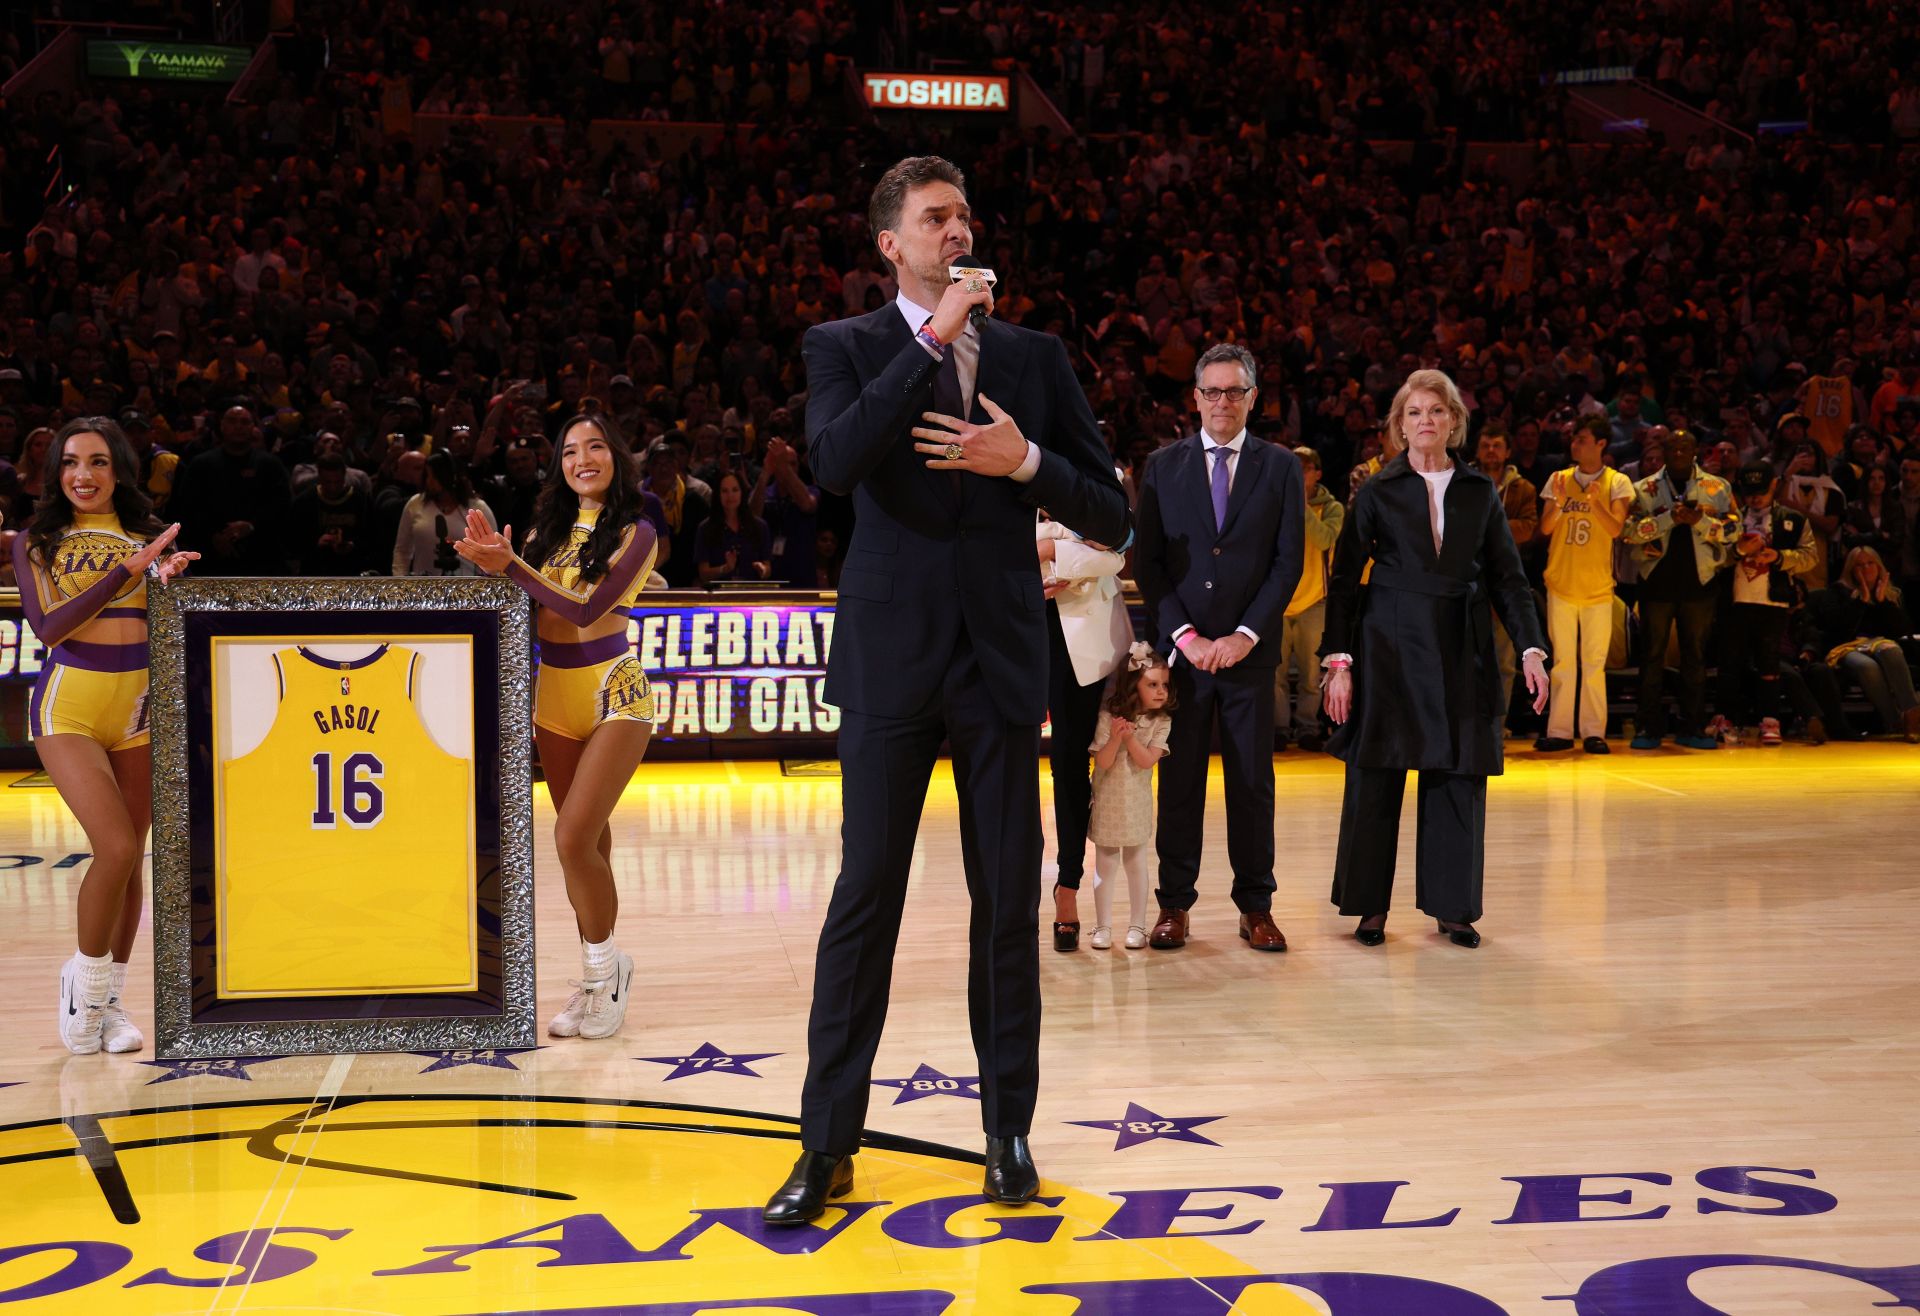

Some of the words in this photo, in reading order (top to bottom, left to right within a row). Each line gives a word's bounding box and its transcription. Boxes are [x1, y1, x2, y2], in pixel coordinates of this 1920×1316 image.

[866, 78, 1007, 108] TOSHIBA
[1815, 393, 1842, 418] 16
[1564, 516, 1592, 545] 16
[313, 704, 380, 735] GASOL
[651, 678, 732, 735] PAU
[749, 677, 841, 733] GAS
[311, 752, 385, 830] 16
[677, 1056, 735, 1069] '72
[899, 1078, 960, 1092] '80
[1113, 1120, 1182, 1135] '82
[0, 1226, 354, 1302] OS
[372, 1164, 1839, 1277] ANGELES
